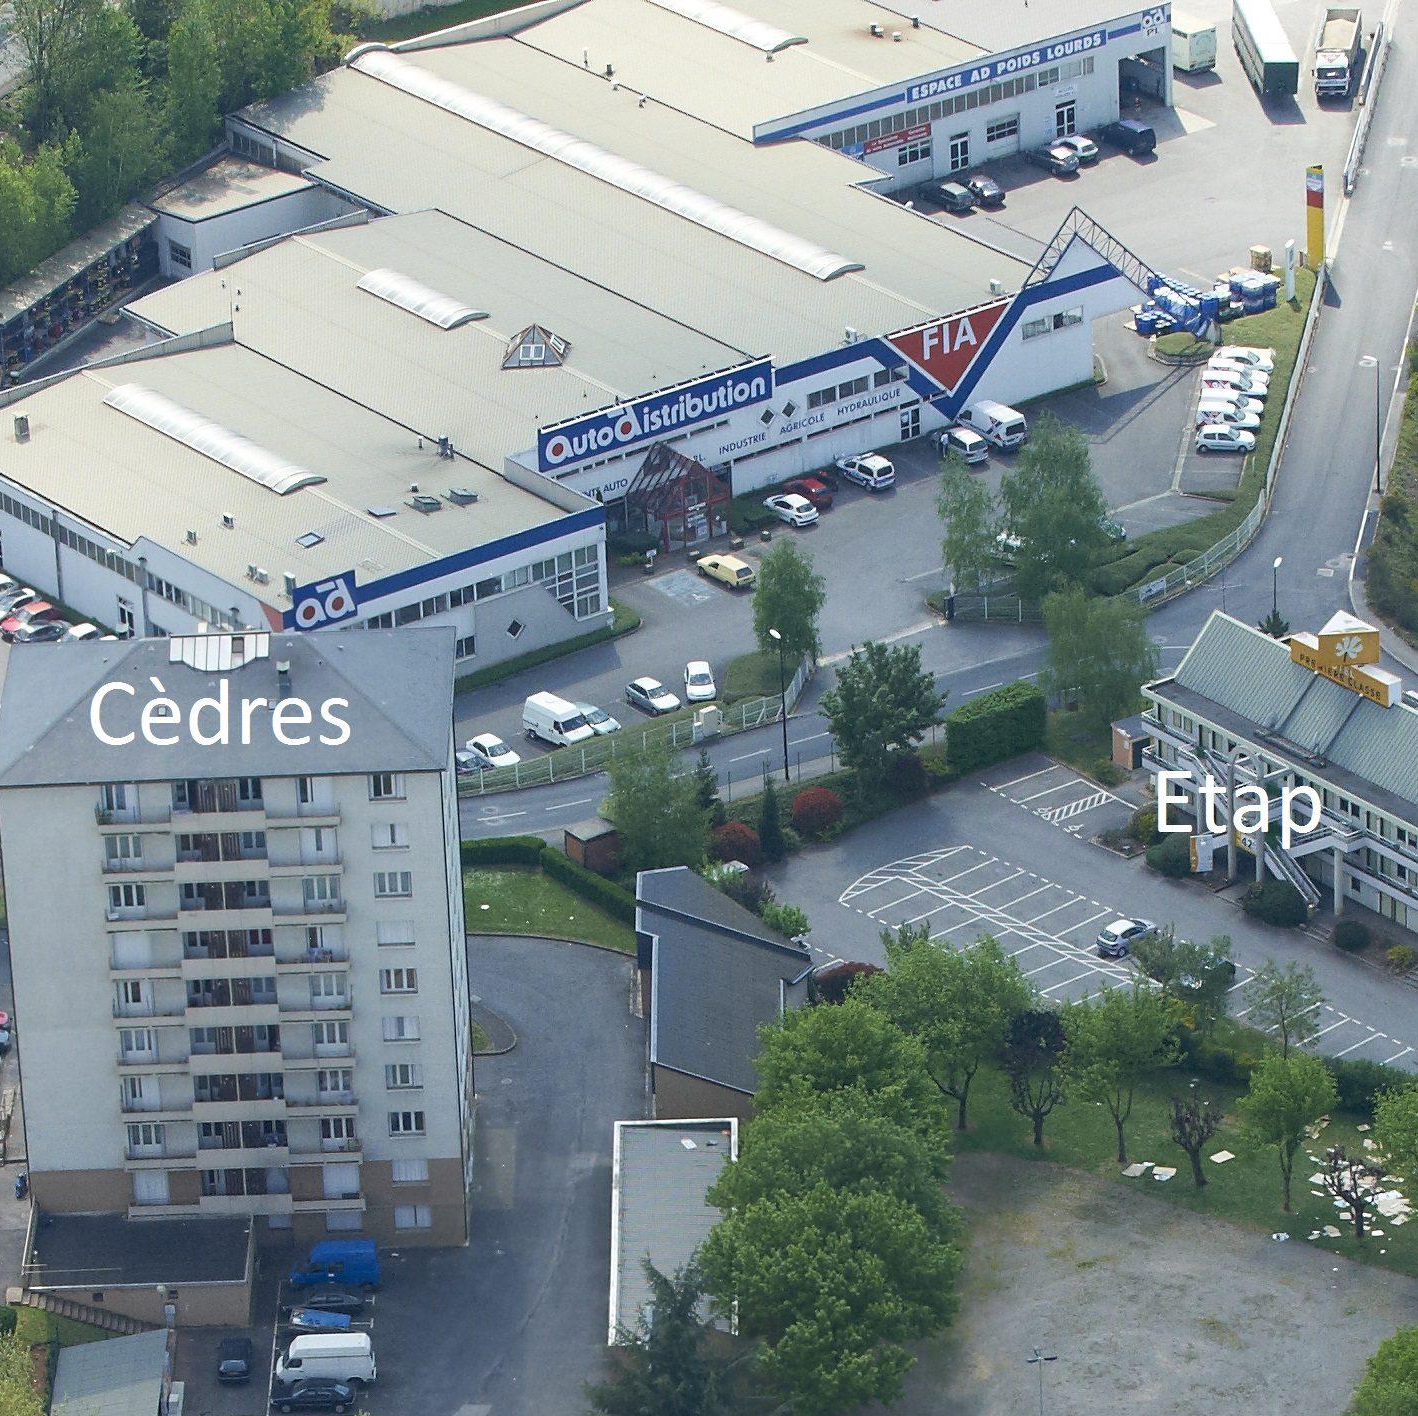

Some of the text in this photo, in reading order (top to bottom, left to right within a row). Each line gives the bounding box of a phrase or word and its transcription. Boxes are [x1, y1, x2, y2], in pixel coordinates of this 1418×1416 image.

[911, 33, 1102, 101] ESPACE AD POIDS LOURDS
[922, 316, 978, 361] FIA
[719, 431, 767, 456] INDUSTRIE
[780, 411, 825, 435] AGRICOLE
[837, 388, 902, 416] HYDRAULIQUE
[603, 478, 629, 493] AUTO
[295, 578, 356, 628] ad
